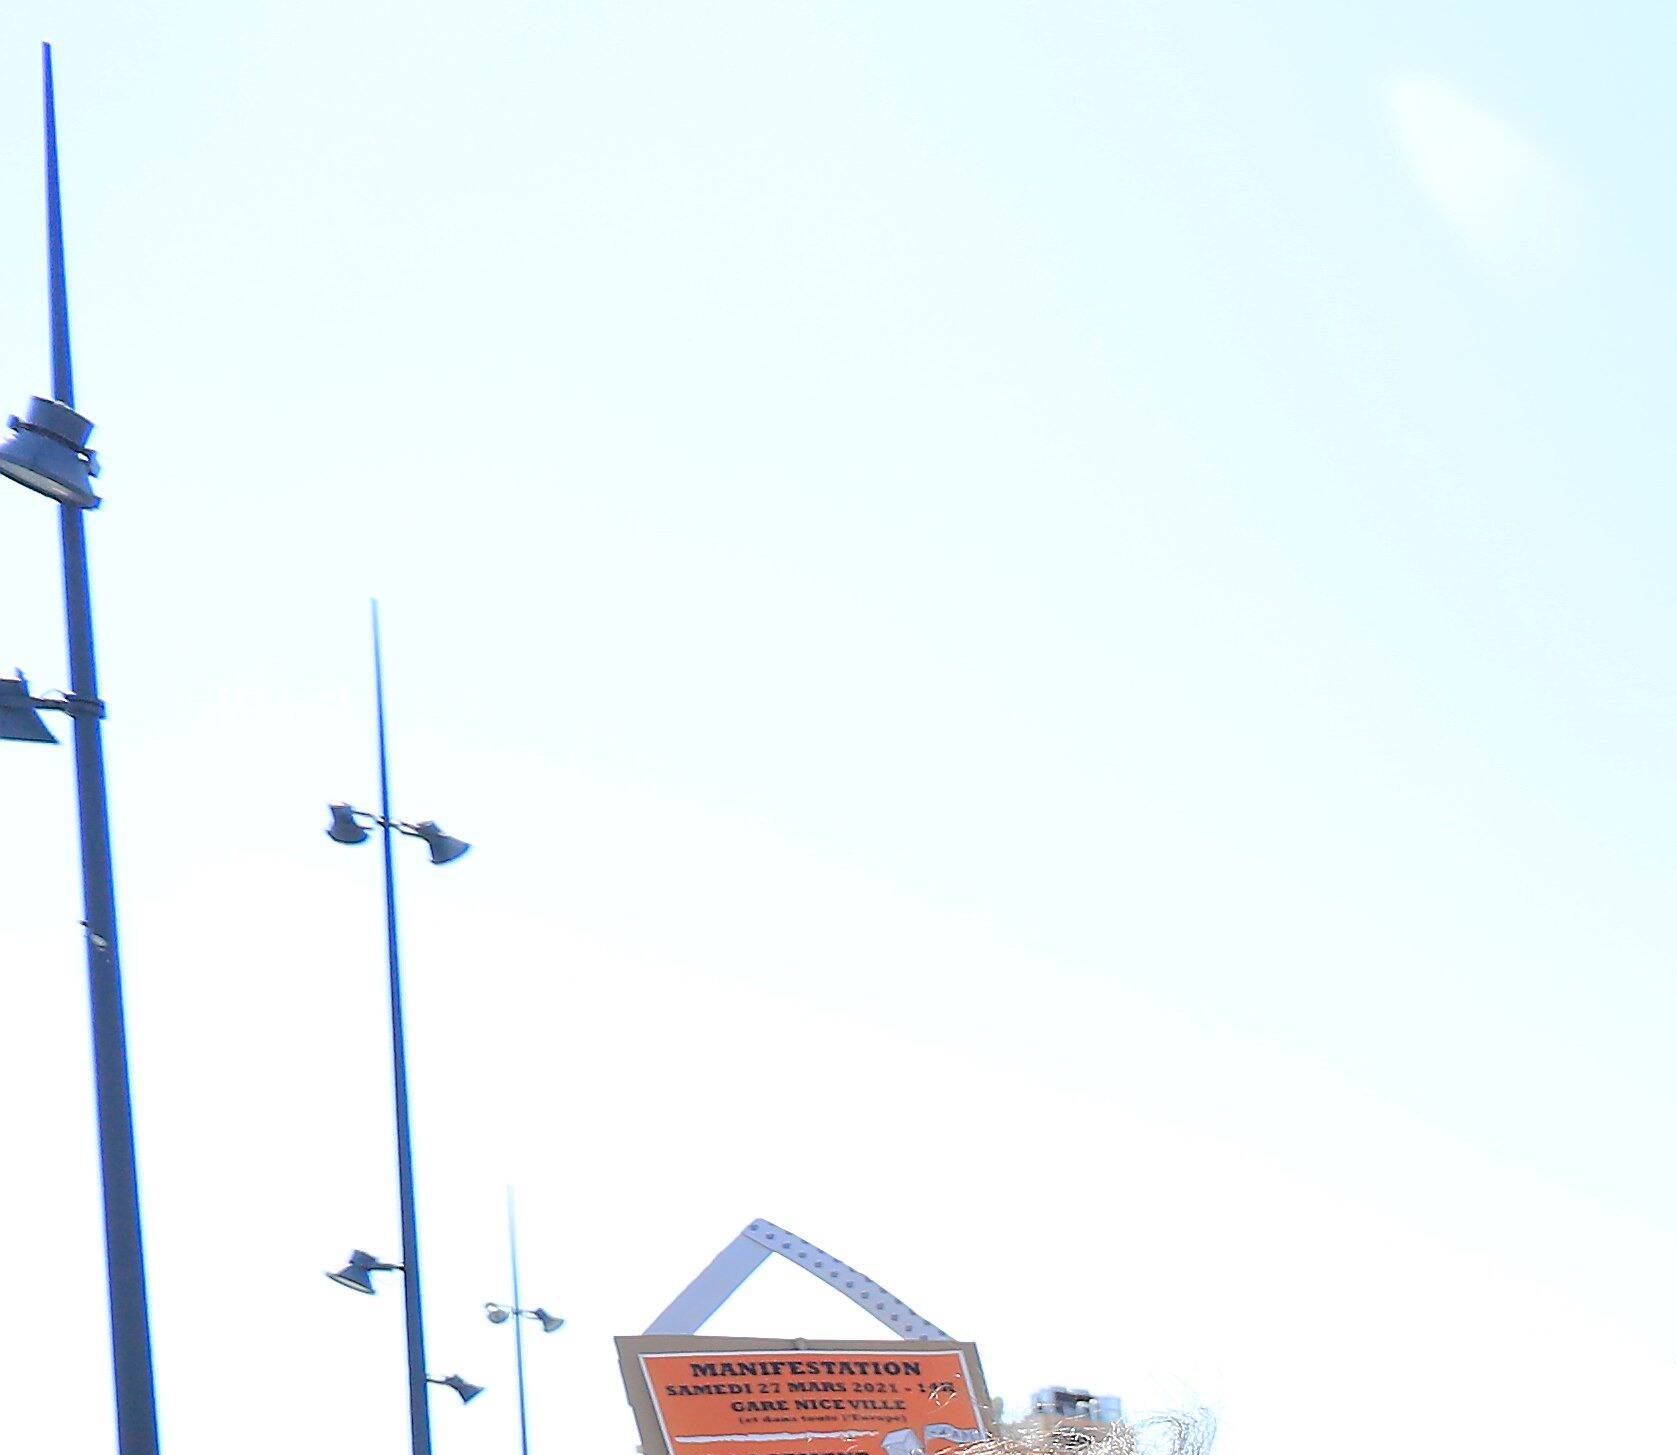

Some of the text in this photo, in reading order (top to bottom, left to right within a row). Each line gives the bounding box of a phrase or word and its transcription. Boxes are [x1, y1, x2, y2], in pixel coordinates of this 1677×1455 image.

[690, 1361, 921, 1377] MANIFESTATION
[666, 1383, 753, 1396] SAMEDI
[760, 1381, 781, 1394] 27
[789, 1380, 846, 1393] MARS
[853, 1382, 898, 1394] 2021
[731, 1400, 906, 1412] GARE NICE VILLE
